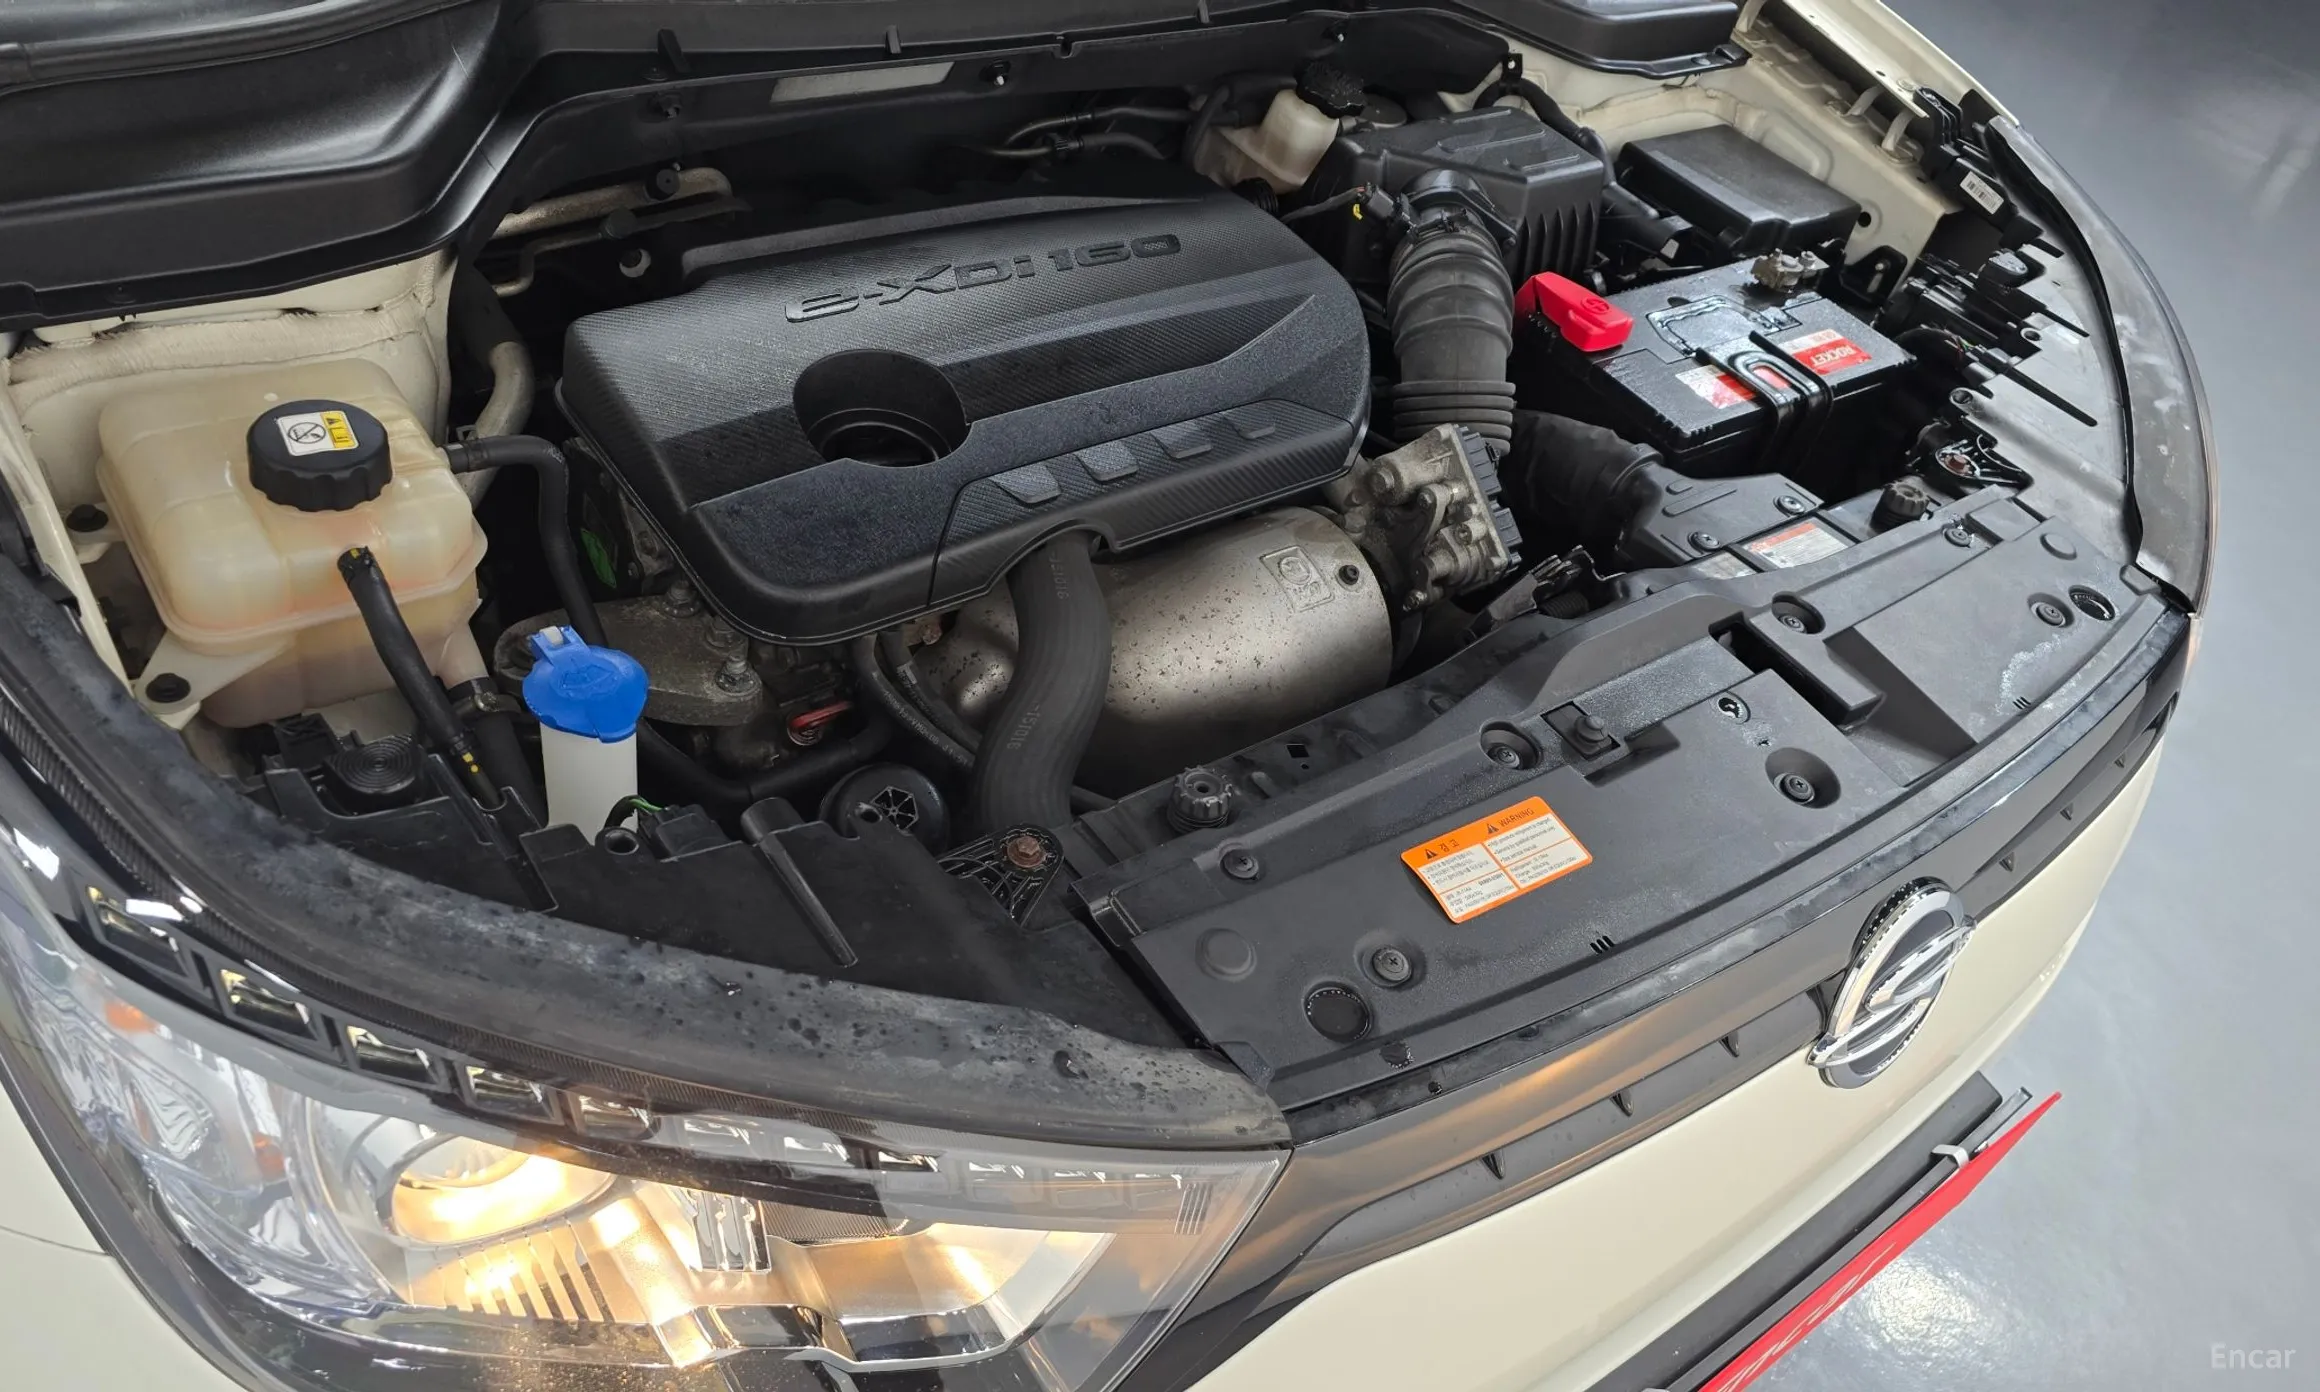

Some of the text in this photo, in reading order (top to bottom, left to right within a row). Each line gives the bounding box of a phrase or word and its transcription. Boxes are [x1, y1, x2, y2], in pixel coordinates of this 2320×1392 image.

[1048, 233, 1182, 272] 160
[1811, 345, 1858, 366] ROCKET
[1498, 808, 1535, 828] WARNING
